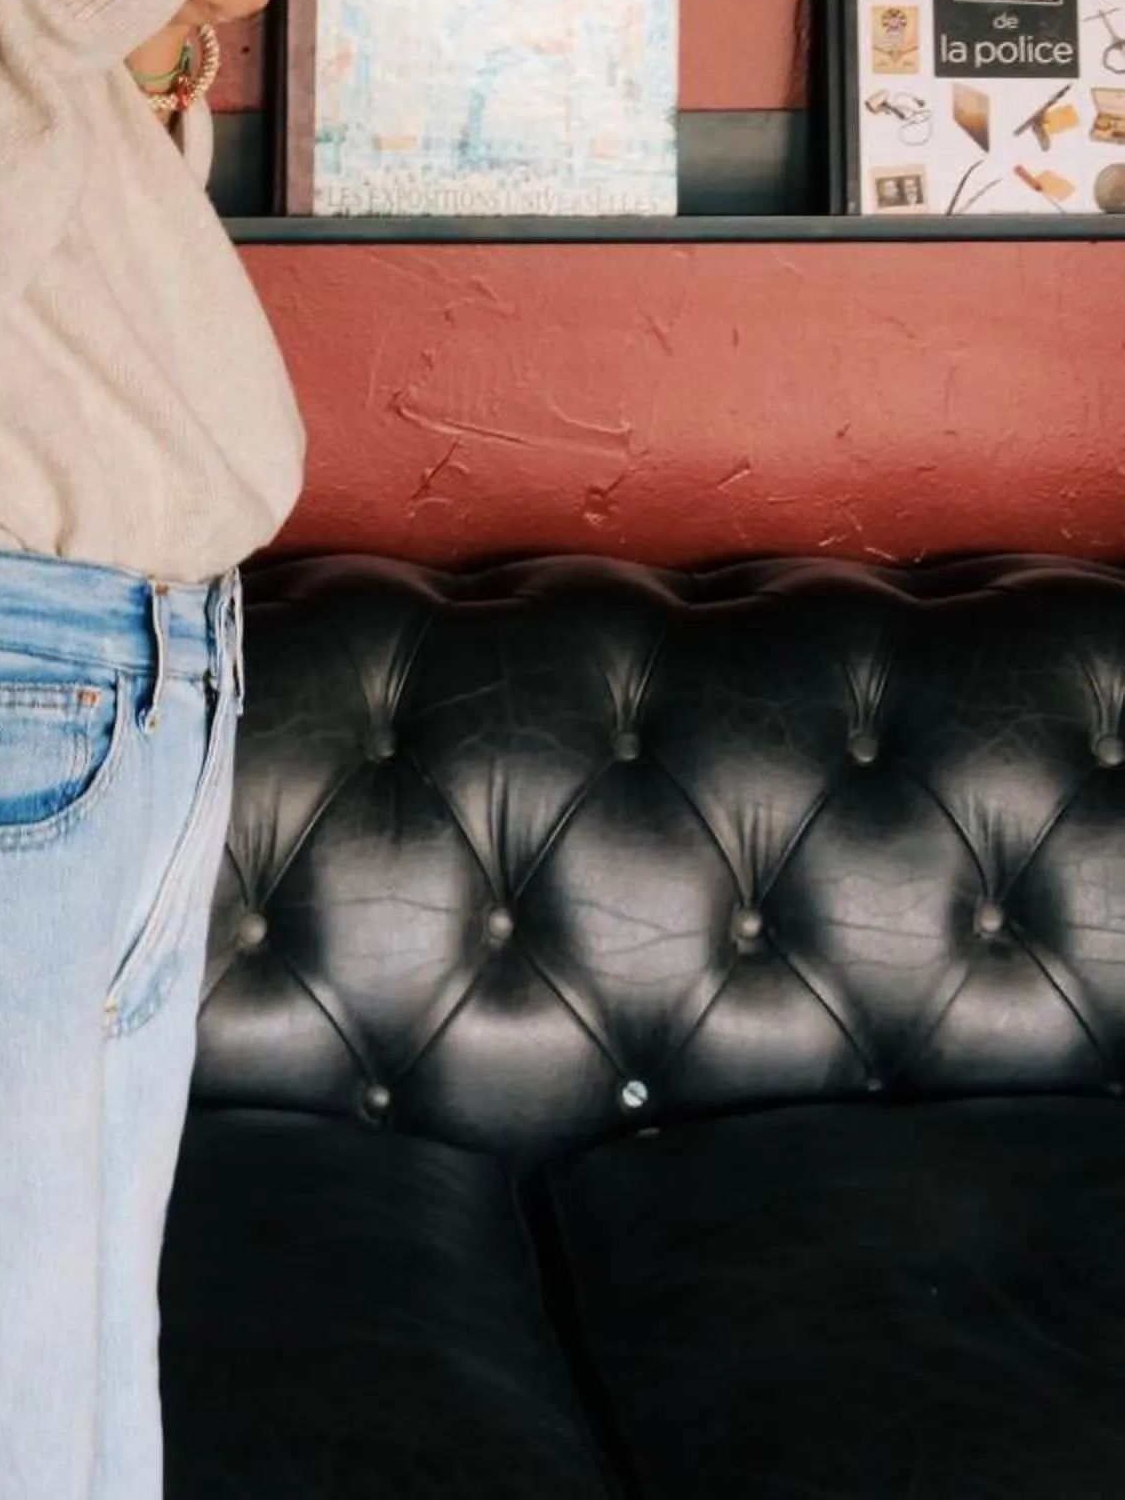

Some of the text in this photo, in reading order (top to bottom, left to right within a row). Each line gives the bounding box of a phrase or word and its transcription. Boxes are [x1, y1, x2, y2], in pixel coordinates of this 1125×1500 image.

[992, 11, 1020, 30] de
[940, 34, 1075, 69] la police
